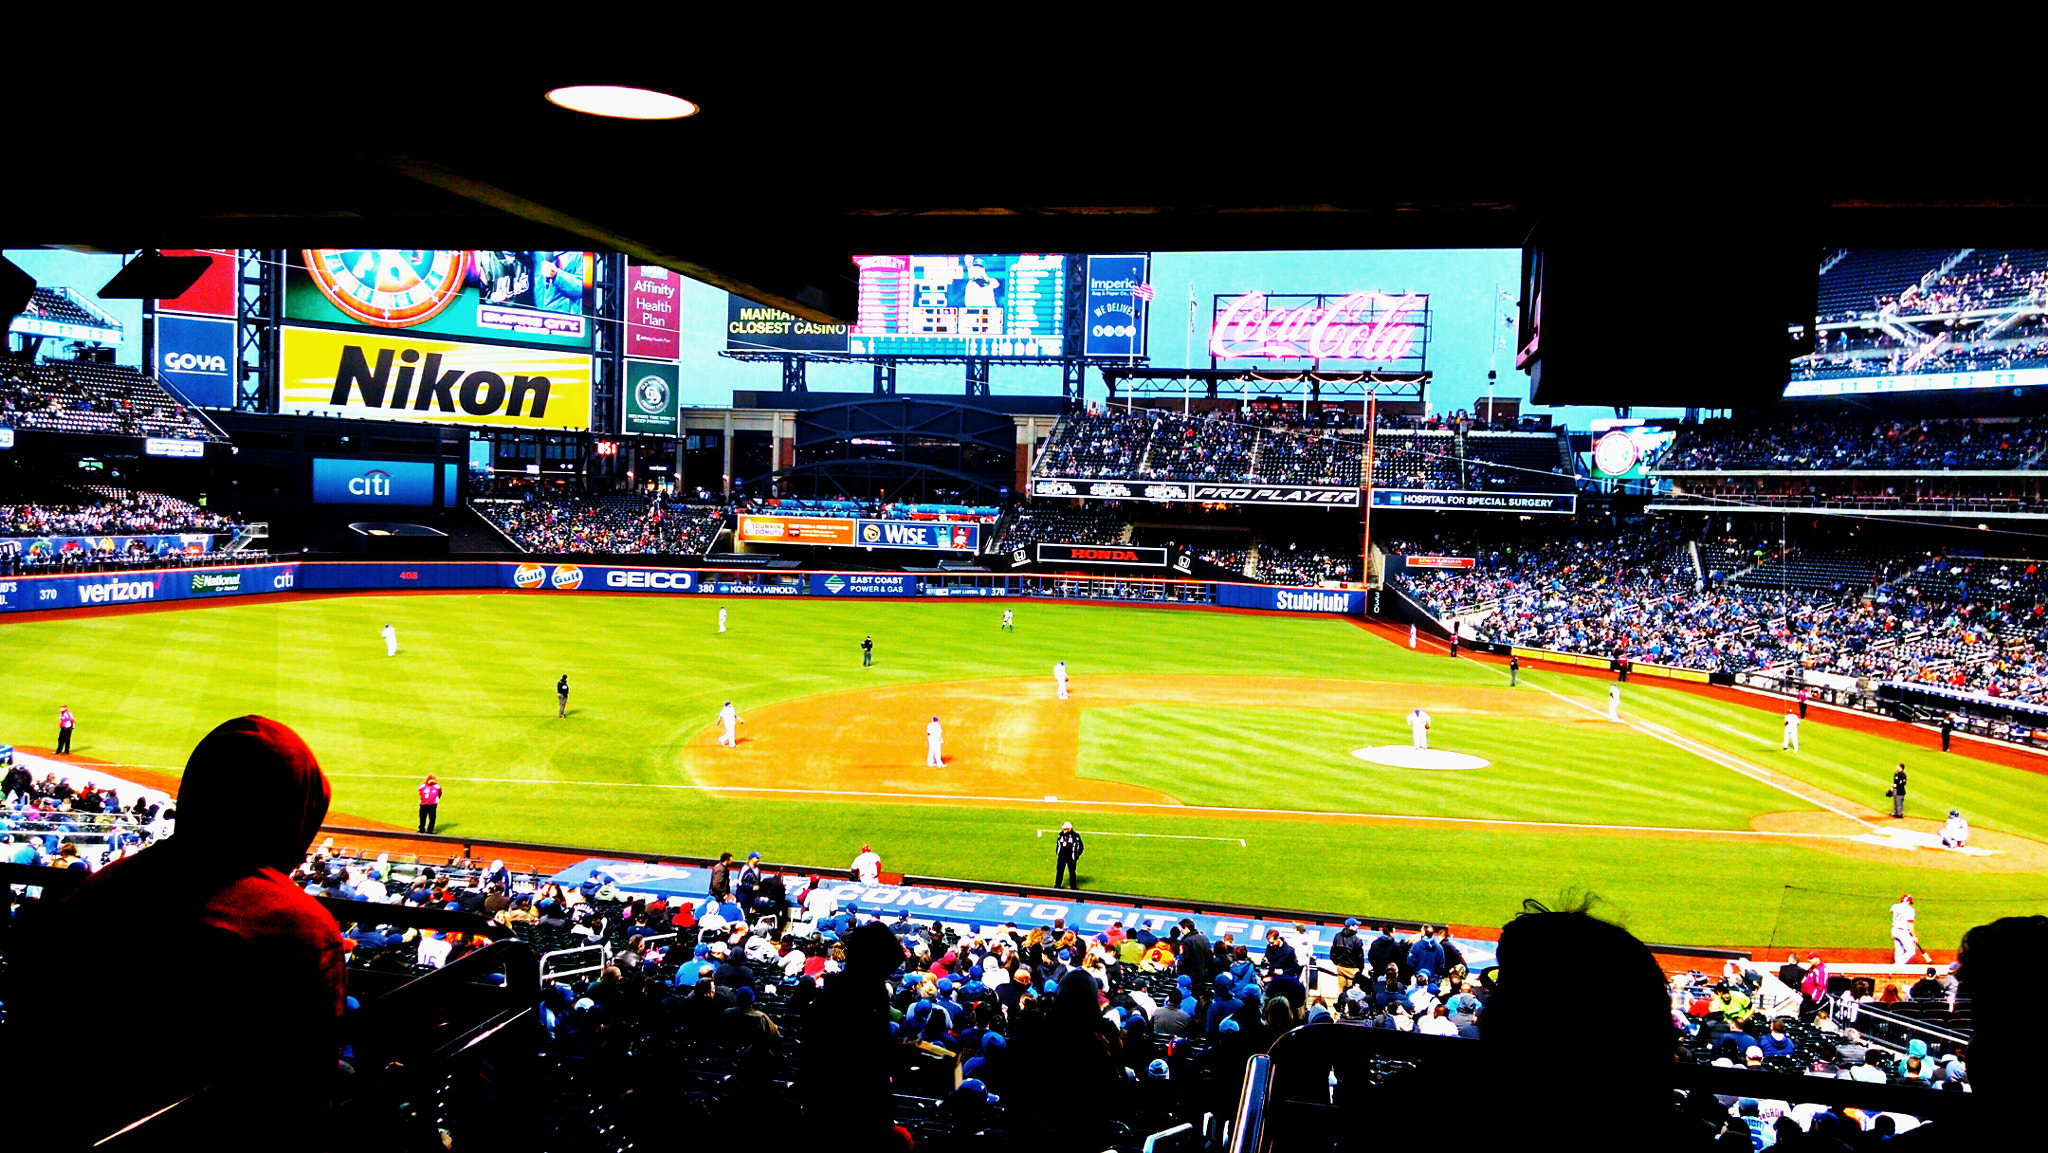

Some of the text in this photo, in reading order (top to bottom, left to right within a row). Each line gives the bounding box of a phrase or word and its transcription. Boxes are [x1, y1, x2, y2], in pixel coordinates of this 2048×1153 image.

[633, 280, 675, 299] Affinity
[636, 297, 672, 313] Health
[1093, 302, 1136, 318] WE DELIVE
[642, 312, 665, 326] Plan
[1211, 290, 1428, 360] Coca-Cola
[729, 321, 847, 335] CLOSEST CASINO
[164, 352, 228, 371] GOYA
[329, 345, 553, 419] Nikon
[348, 470, 390, 497] citi
[1196, 487, 1357, 503] PRO PLAYER
[1403, 495, 1446, 505] HOSPITAL
[1448, 496, 1465, 505] FOR
[1466, 497, 1507, 507] SPECIAL
[1508, 498, 1554, 508] SURGERY
[884, 524, 929, 545] WISE
[1071, 549, 1139, 561] HONDA
[203, 574, 240, 587] National
[273, 570, 294, 589] citi
[400, 571, 418, 580] 408
[516, 570, 543, 583] Gulf
[553, 571, 581, 585] Gulf
[606, 571, 691, 589] GEICO
[850, 576, 903, 584] EAST COAST
[40, 588, 57, 600] 370
[78, 578, 154, 603] verizon
[698, 584, 715, 593] 380
[730, 585, 798, 594] KONICA MINOLTA
[991, 587, 1006, 596] 370
[1276, 590, 1349, 613] StubHub!
[1000, 899, 1070, 921] TO
[1085, 908, 1180, 931] CIT
